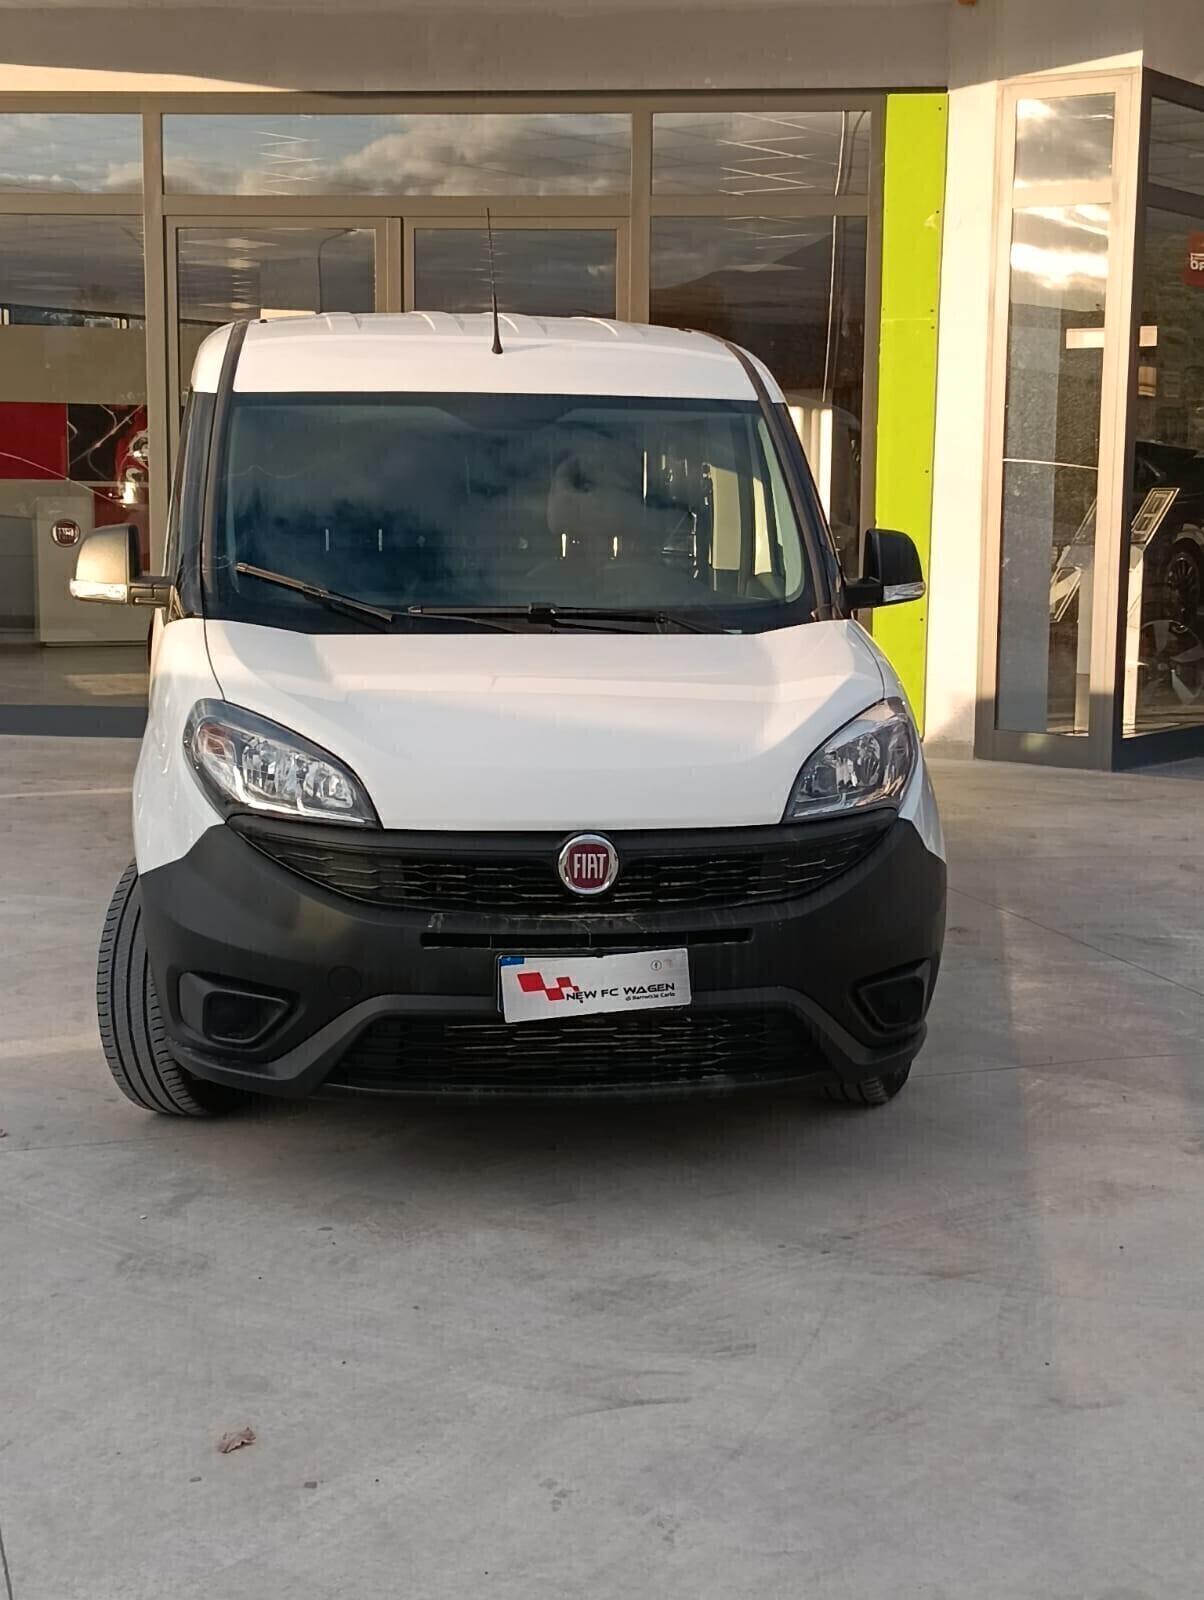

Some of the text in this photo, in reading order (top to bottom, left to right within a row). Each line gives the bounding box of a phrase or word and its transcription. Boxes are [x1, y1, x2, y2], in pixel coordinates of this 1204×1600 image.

[574, 853, 607, 879] FIAT
[566, 990, 597, 1001] NEW
[601, 988, 619, 998] FC
[623, 982, 675, 995] WAGEN
